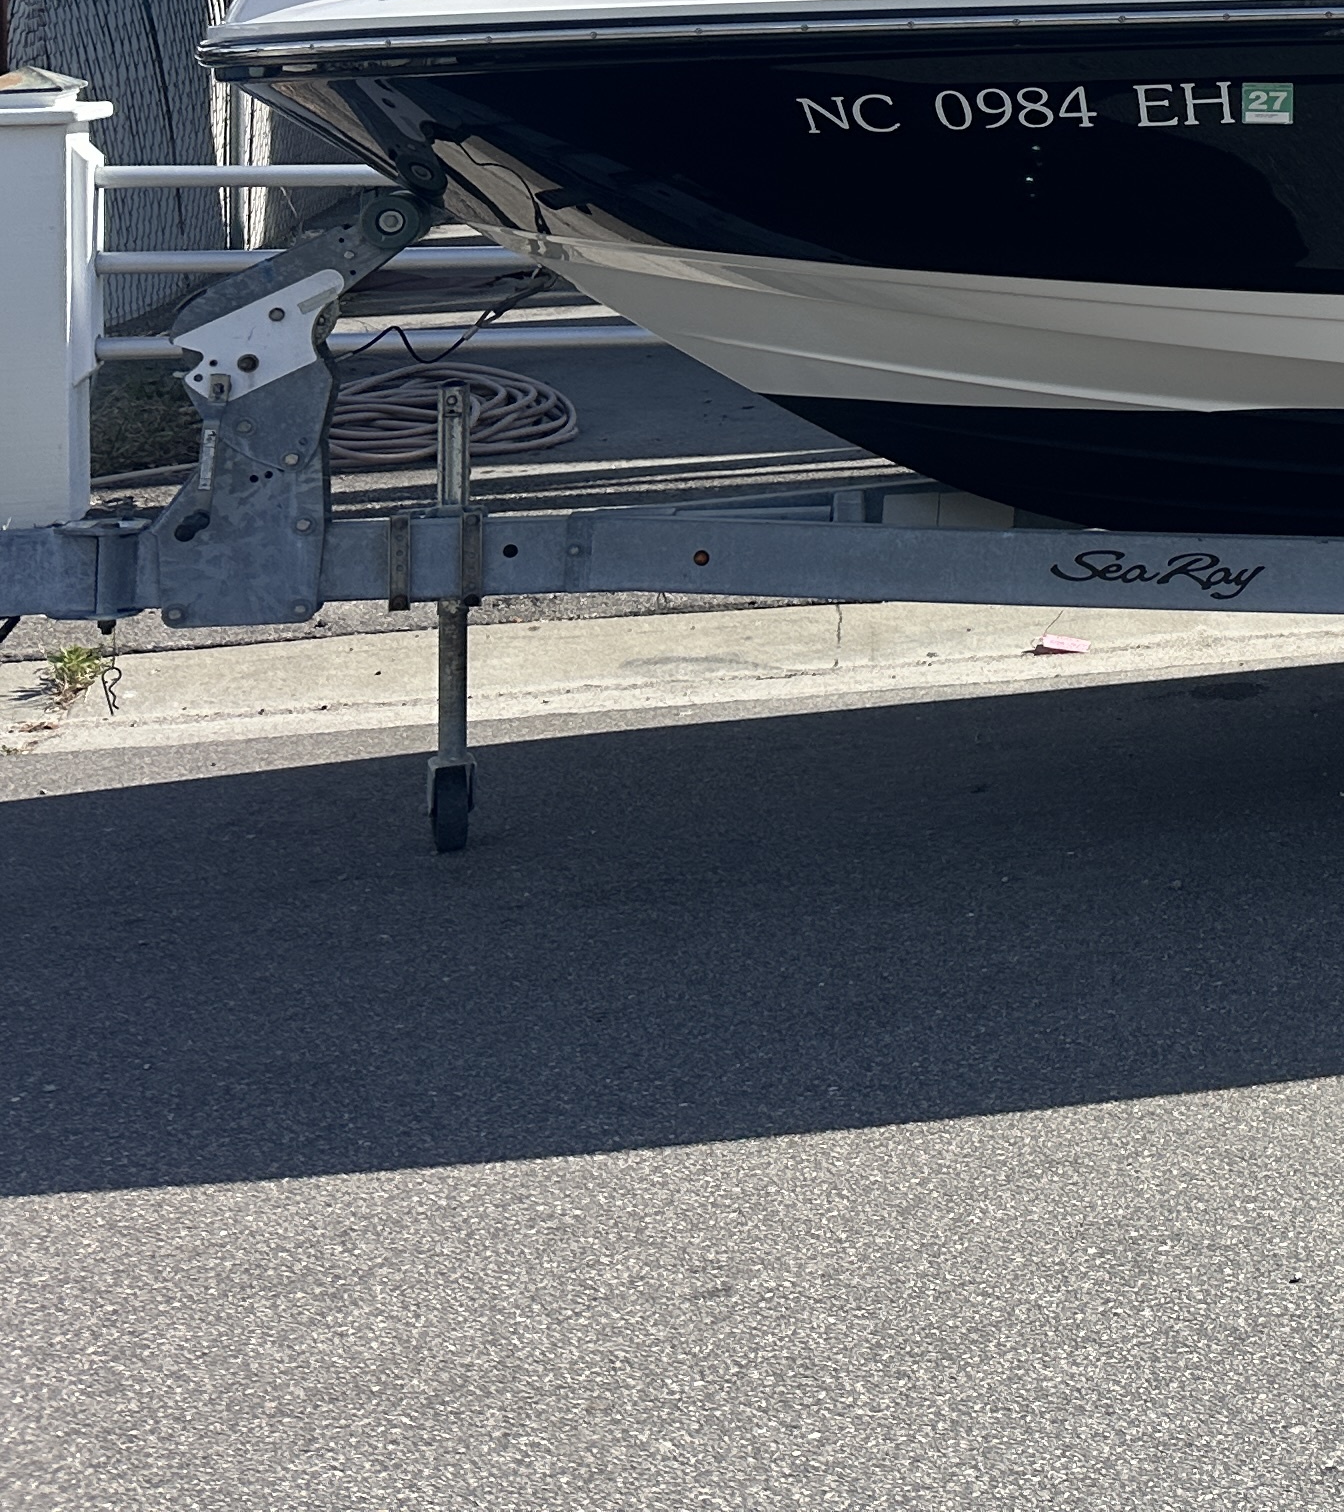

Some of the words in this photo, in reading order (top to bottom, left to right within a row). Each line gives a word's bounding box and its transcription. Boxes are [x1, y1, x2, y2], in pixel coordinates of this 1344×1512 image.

[796, 93, 901, 134] NC
[934, 85, 1098, 131] 0984
[1133, 81, 1235, 127] EH
[1248, 90, 1287, 110] 27
[1050, 549, 1160, 583] Sea
[1157, 552, 1265, 600] Ray
